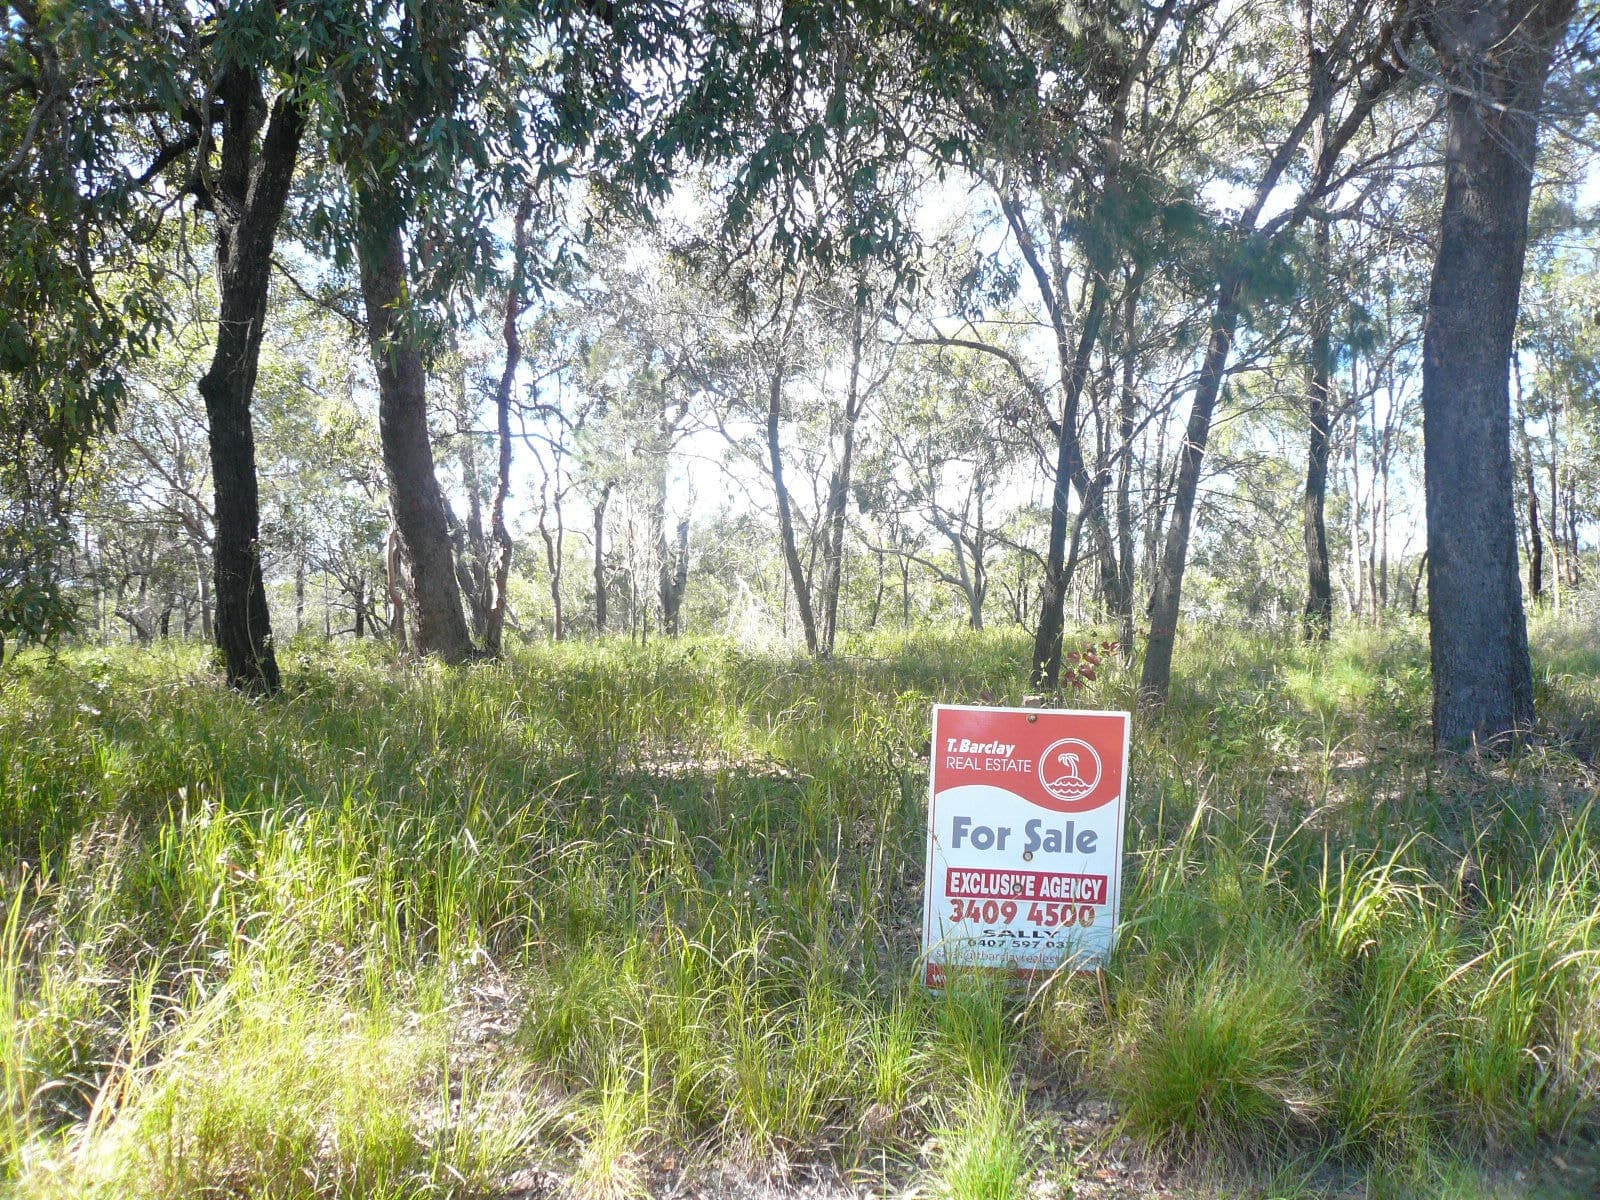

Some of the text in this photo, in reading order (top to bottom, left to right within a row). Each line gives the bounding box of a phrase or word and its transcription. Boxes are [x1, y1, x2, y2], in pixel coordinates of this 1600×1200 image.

[946, 757, 1031, 773] REAL ESTATE
[952, 816, 1098, 854] For Sale
[950, 871, 1102, 900] EXCLUSIVE AGENCY
[950, 899, 1096, 928] 3409 4500
[968, 939, 1006, 948] 0407
[1012, 940, 1040, 949] 597
[983, 929, 1060, 938] SALLY
